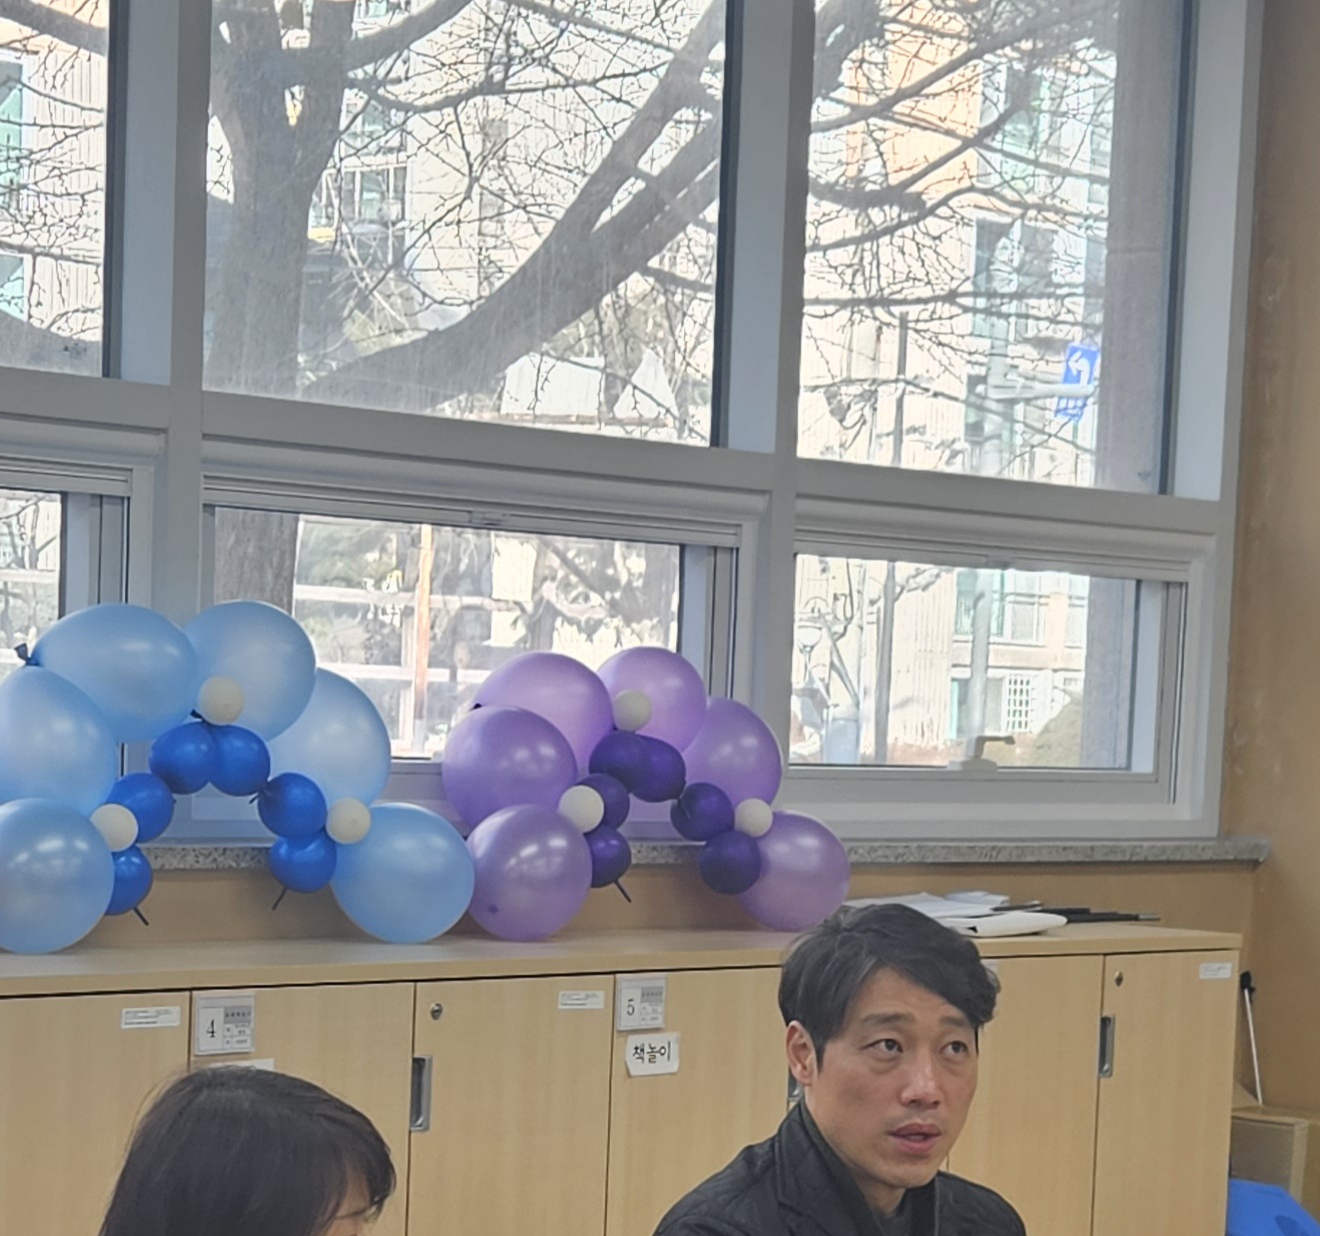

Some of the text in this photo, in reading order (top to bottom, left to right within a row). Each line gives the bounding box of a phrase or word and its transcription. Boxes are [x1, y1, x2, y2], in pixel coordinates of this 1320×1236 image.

[626, 998, 636, 1016] 5
[205, 1018, 217, 1038] 4
[631, 1040, 671, 1065] 책놀이
